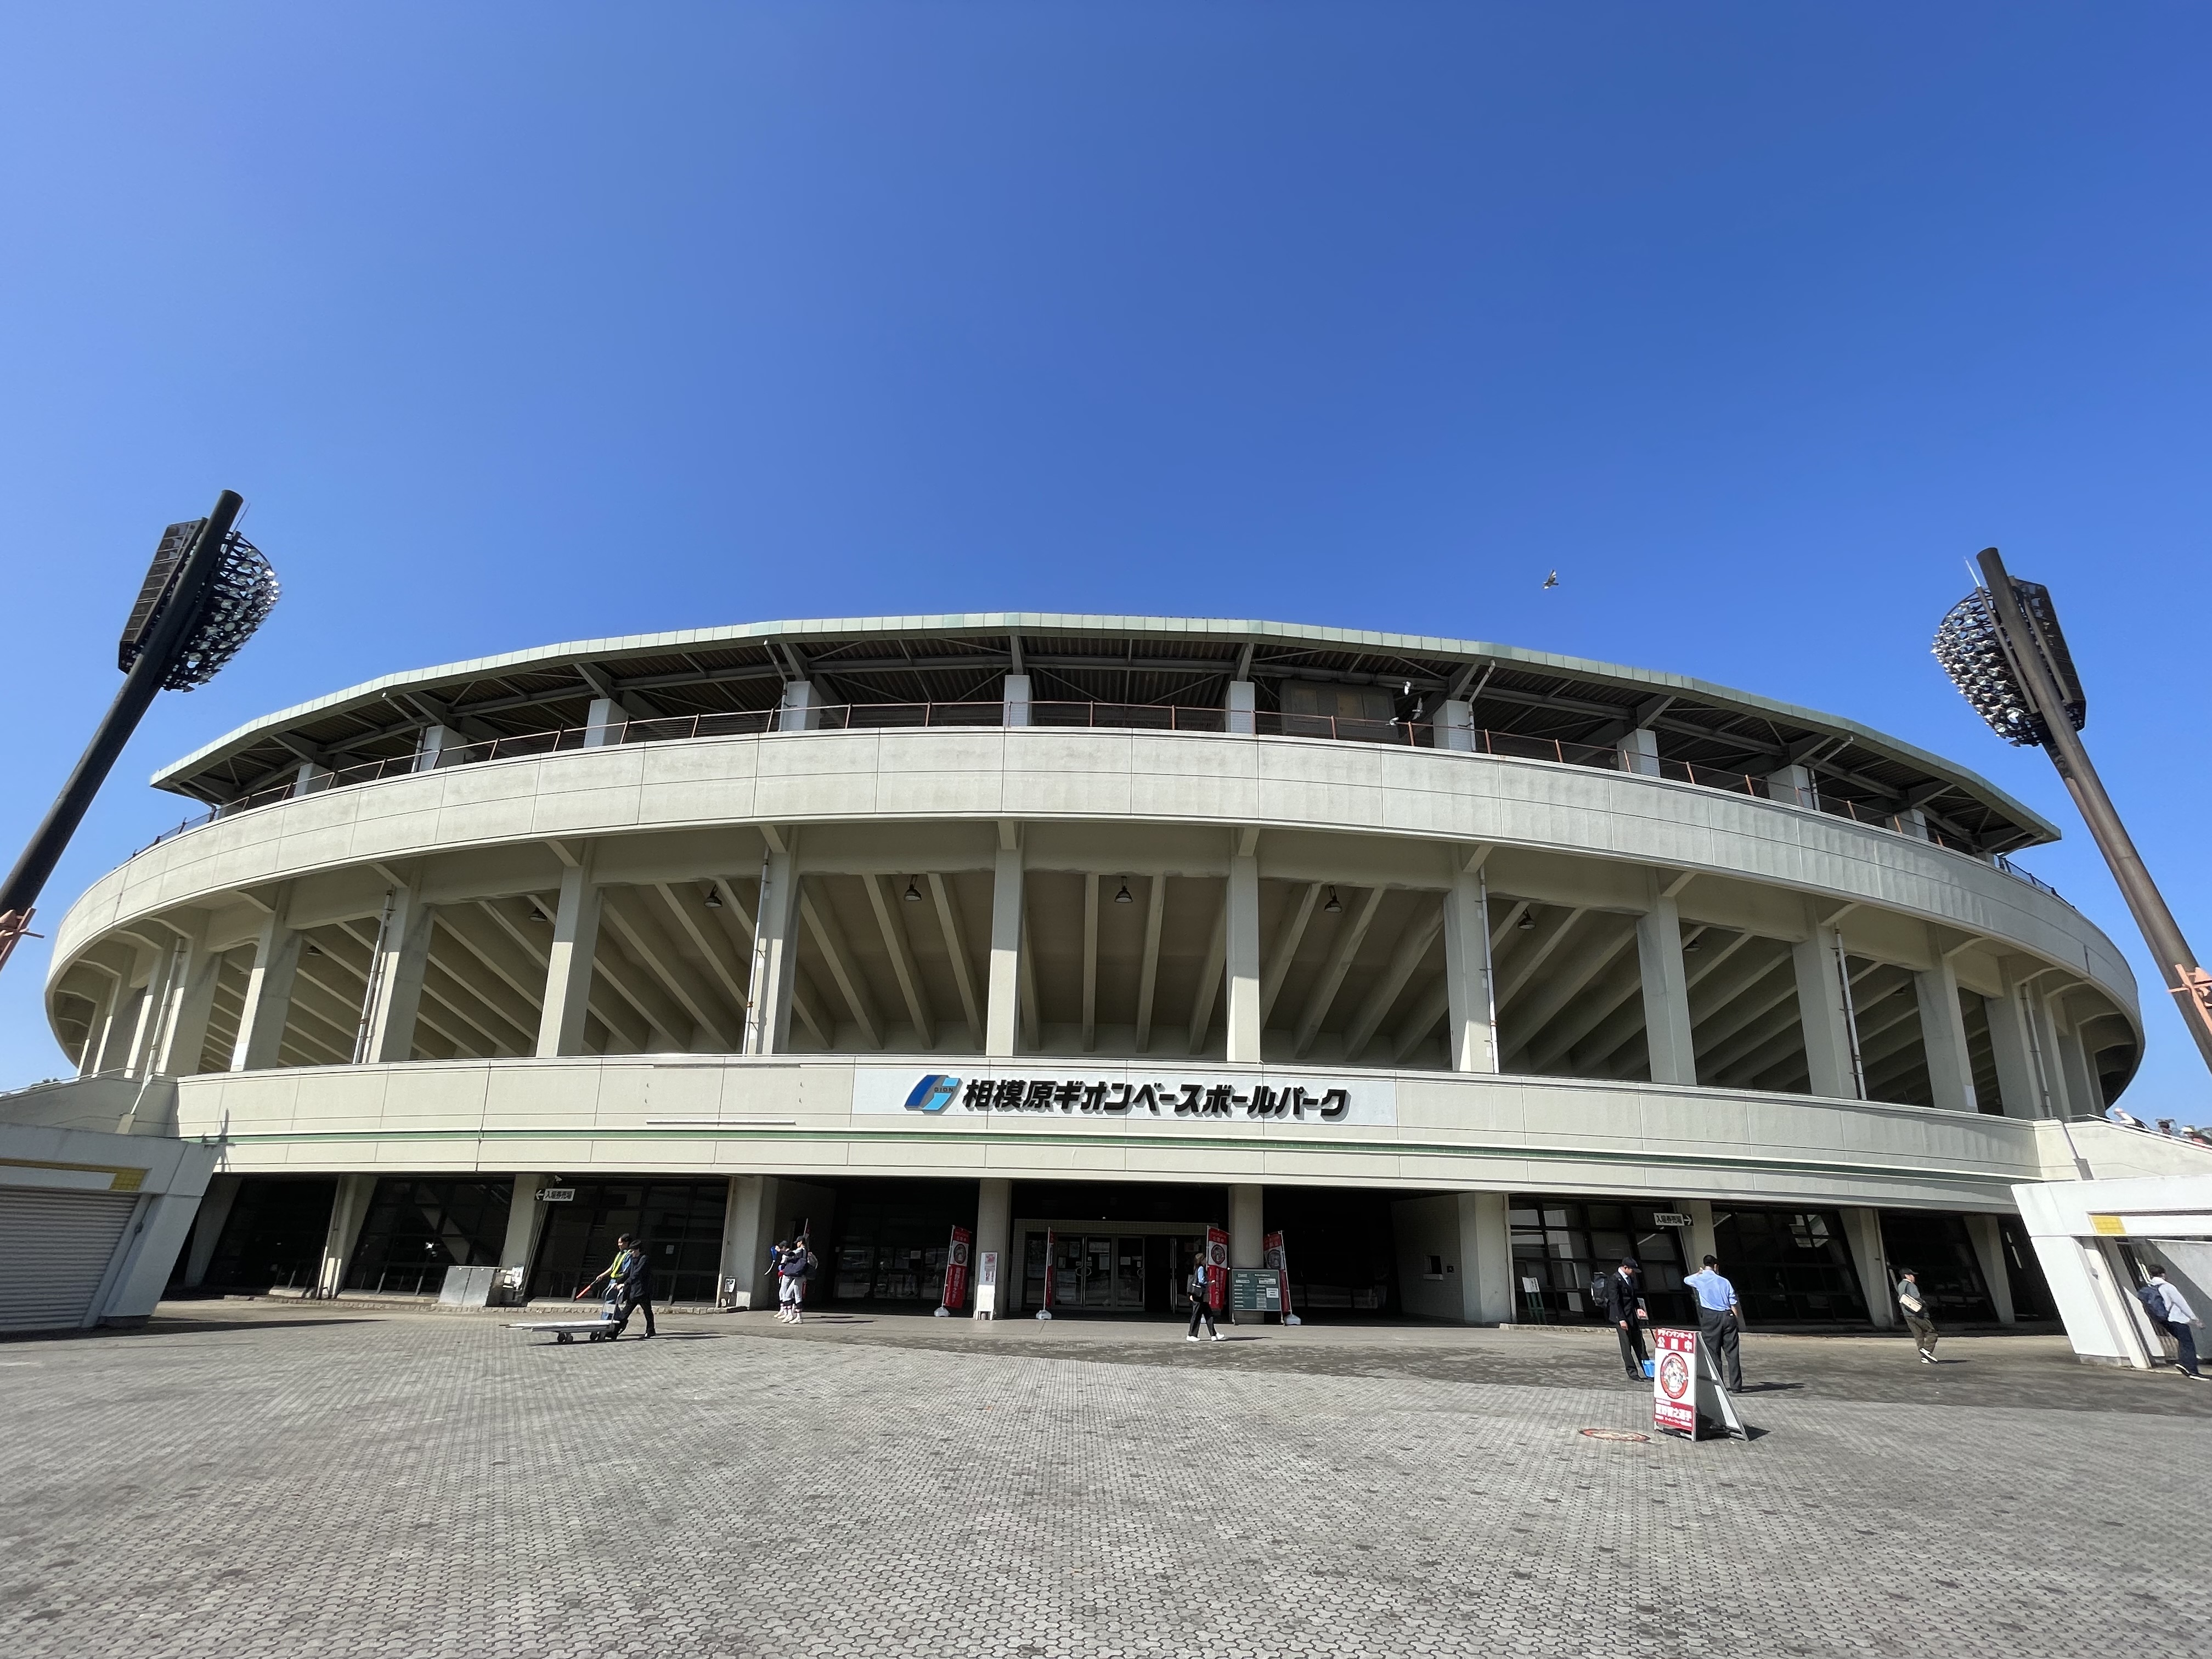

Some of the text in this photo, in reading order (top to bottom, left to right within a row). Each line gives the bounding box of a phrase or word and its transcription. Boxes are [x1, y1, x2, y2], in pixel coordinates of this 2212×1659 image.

[963, 1079, 1347, 1116] 相模原ギオンベースボールパーク
